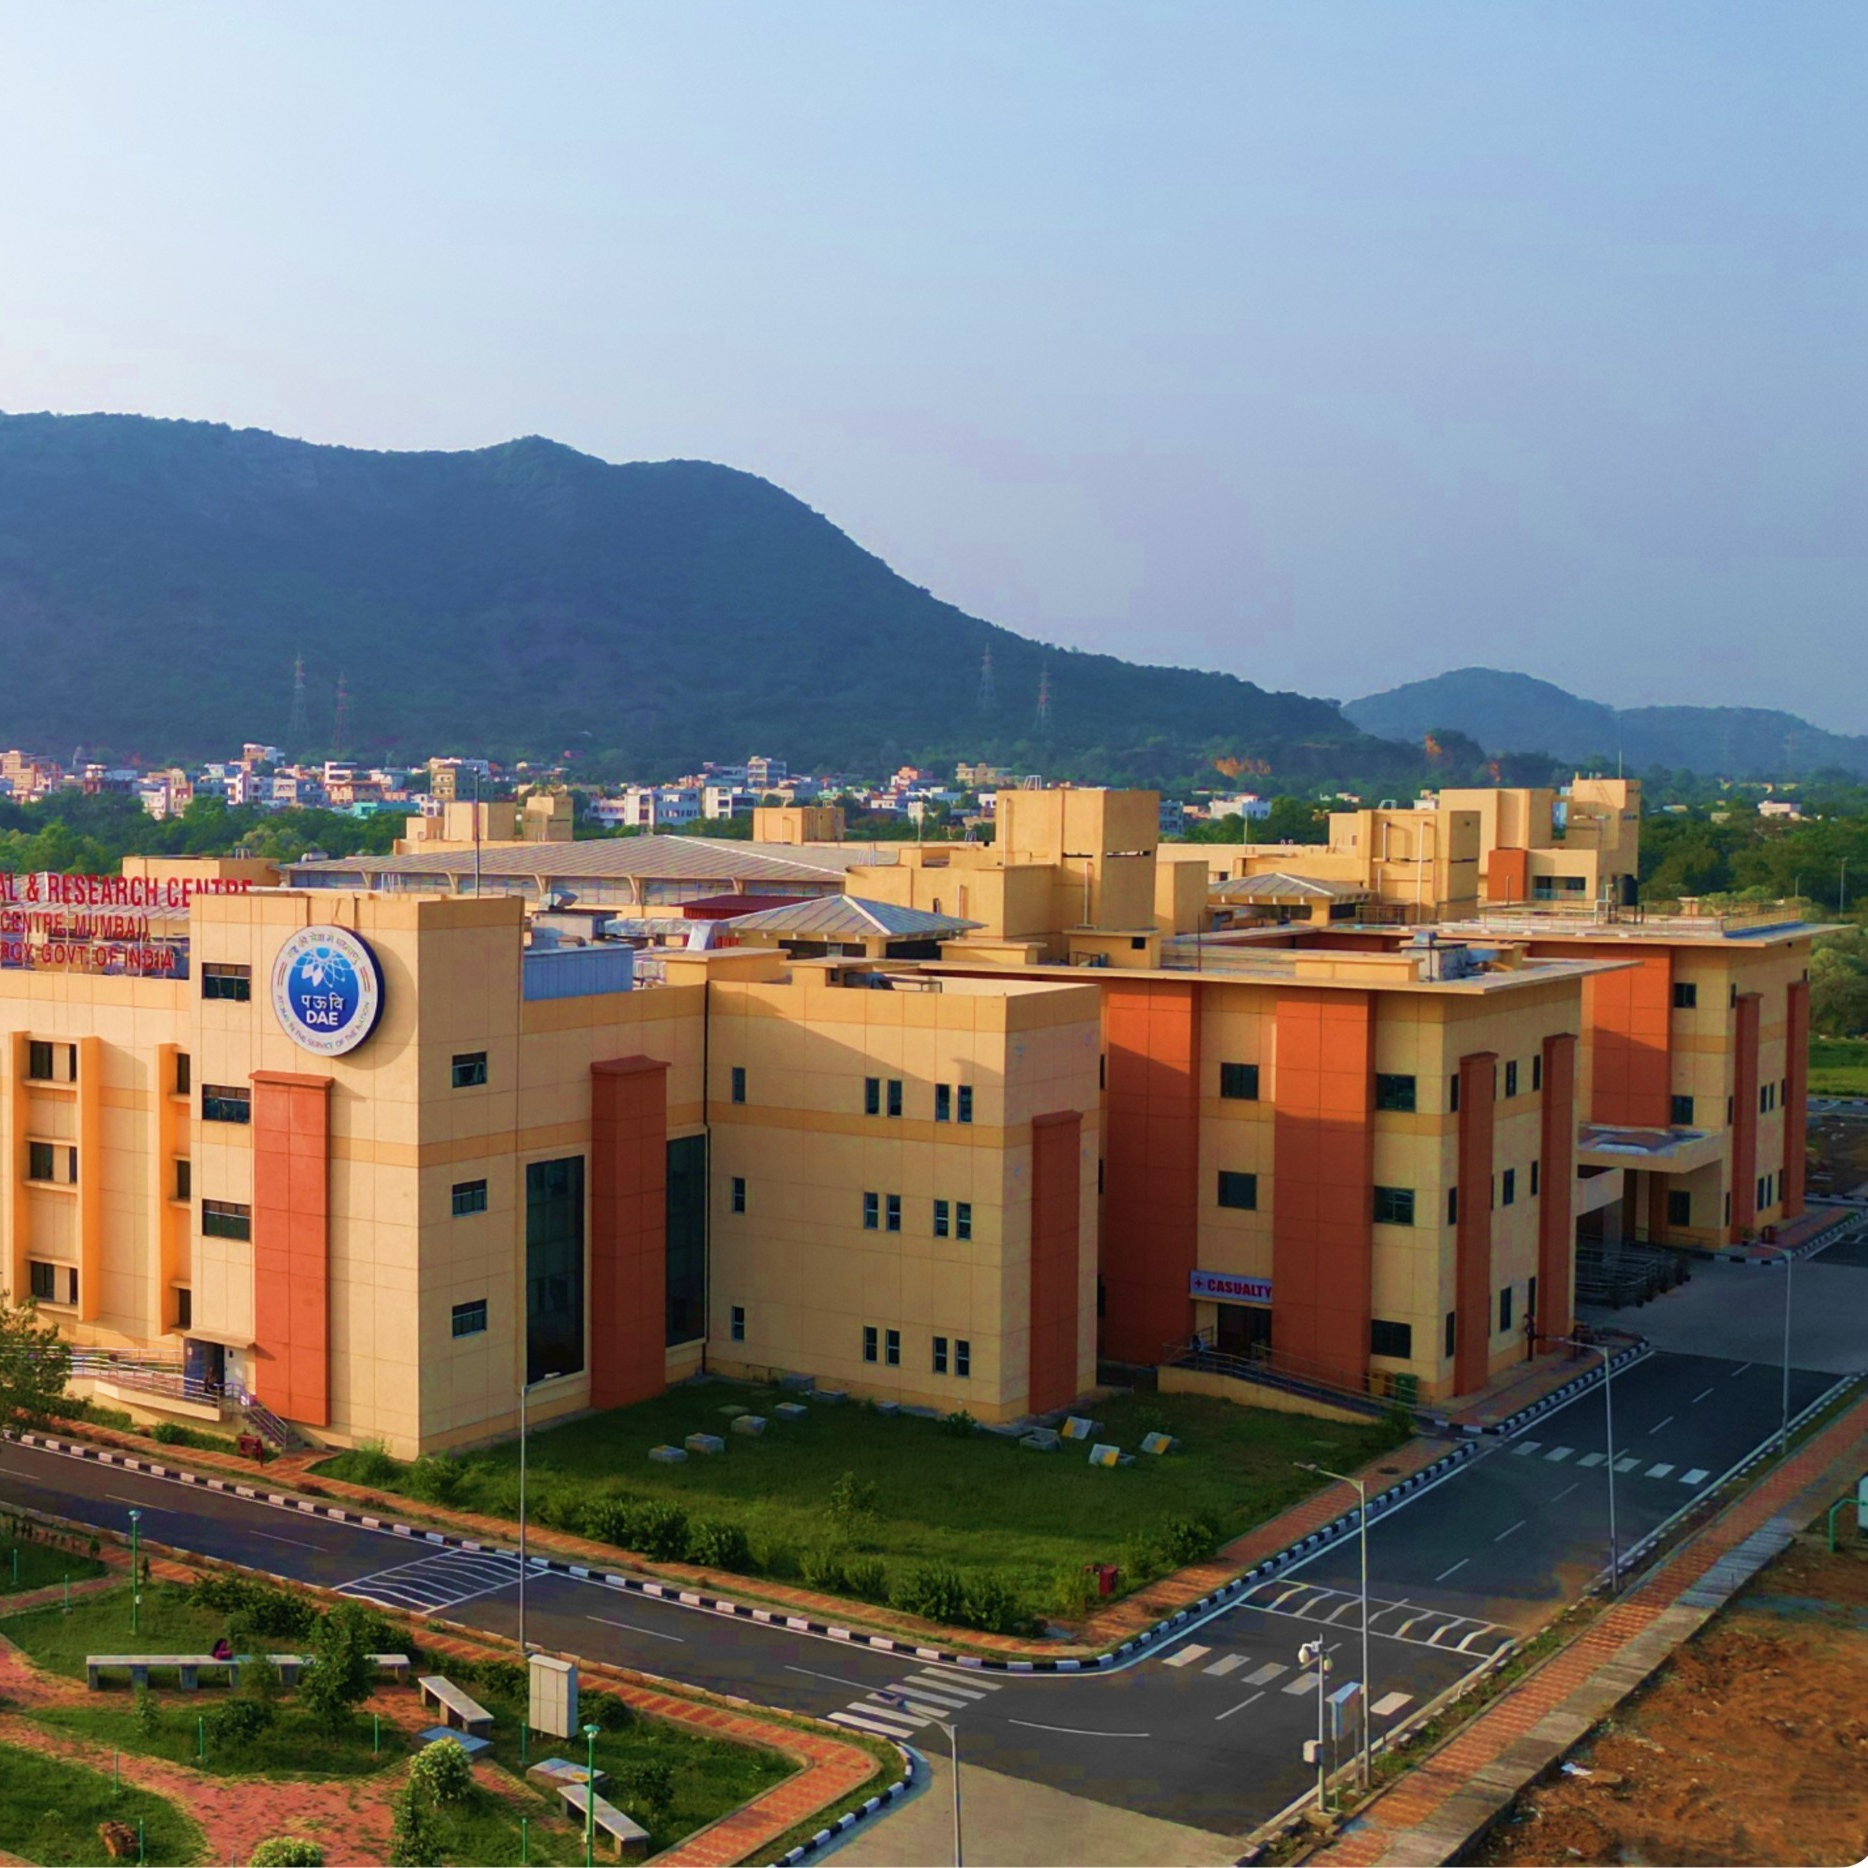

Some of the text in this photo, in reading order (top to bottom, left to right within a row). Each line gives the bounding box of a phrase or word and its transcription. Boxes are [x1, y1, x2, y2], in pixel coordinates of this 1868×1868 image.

[27, 873, 39, 903] &
[48, 873, 158, 906] RESEARCH
[95, 946, 118, 967] OF
[124, 946, 174, 970] INDIA
[306, 1010, 339, 1026] DAE
[1207, 1278, 1273, 1298] CASUALTY
